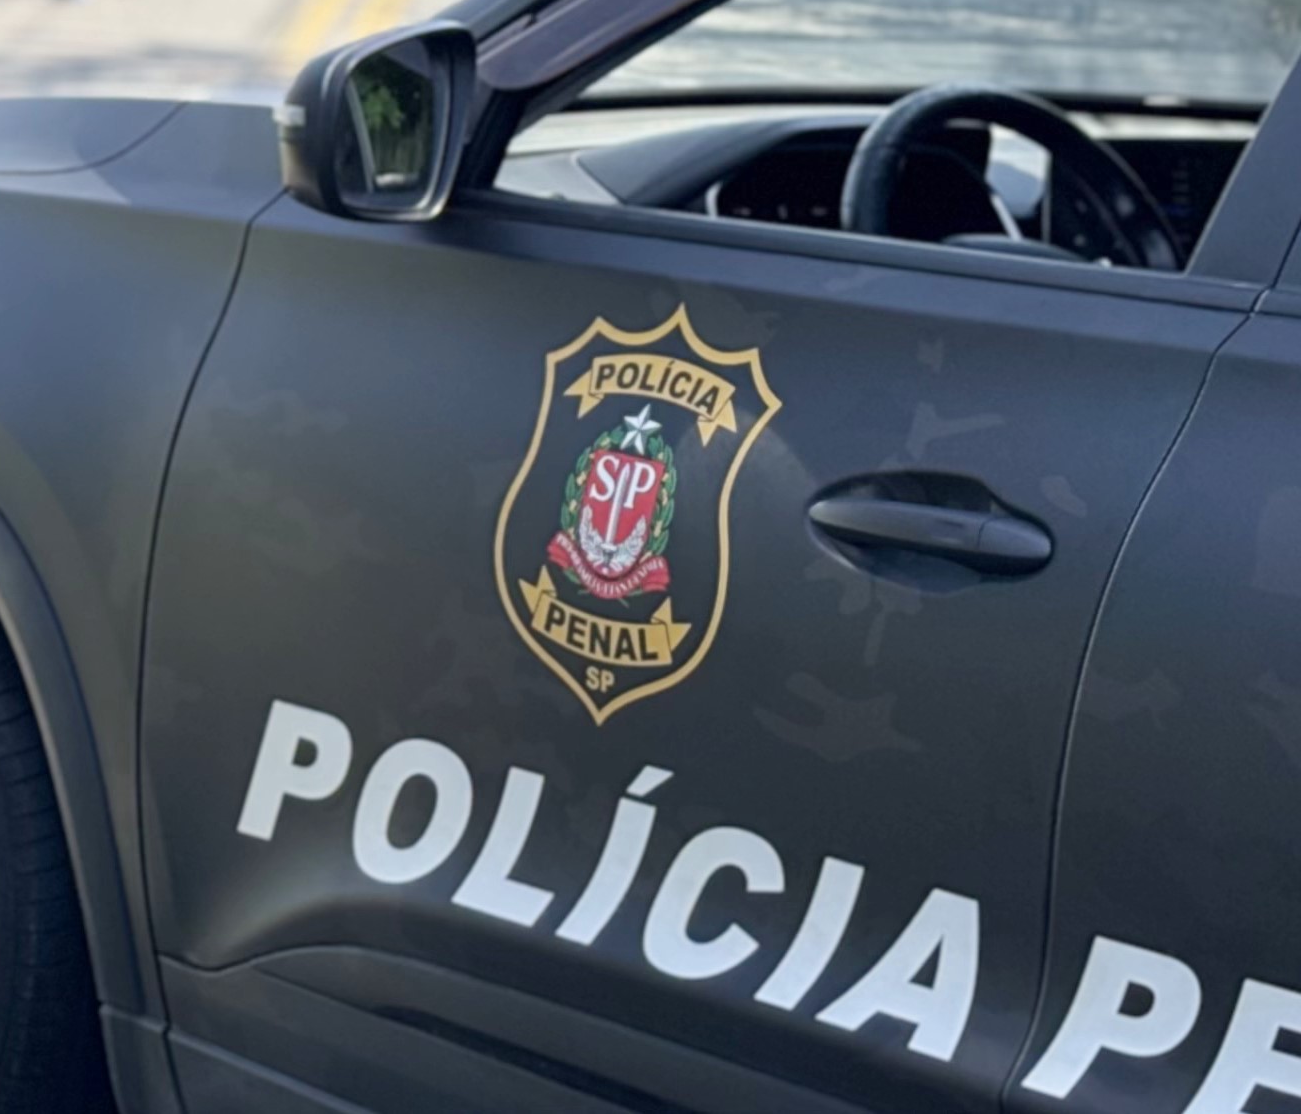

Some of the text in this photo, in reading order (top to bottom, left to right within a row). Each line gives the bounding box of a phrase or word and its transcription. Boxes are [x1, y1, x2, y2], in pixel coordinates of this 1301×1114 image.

[595, 360, 721, 416] POLÍCIA
[543, 603, 660, 661] PENAL
[585, 666, 615, 692] SP
[236, 699, 980, 1061] POLÍCIA
